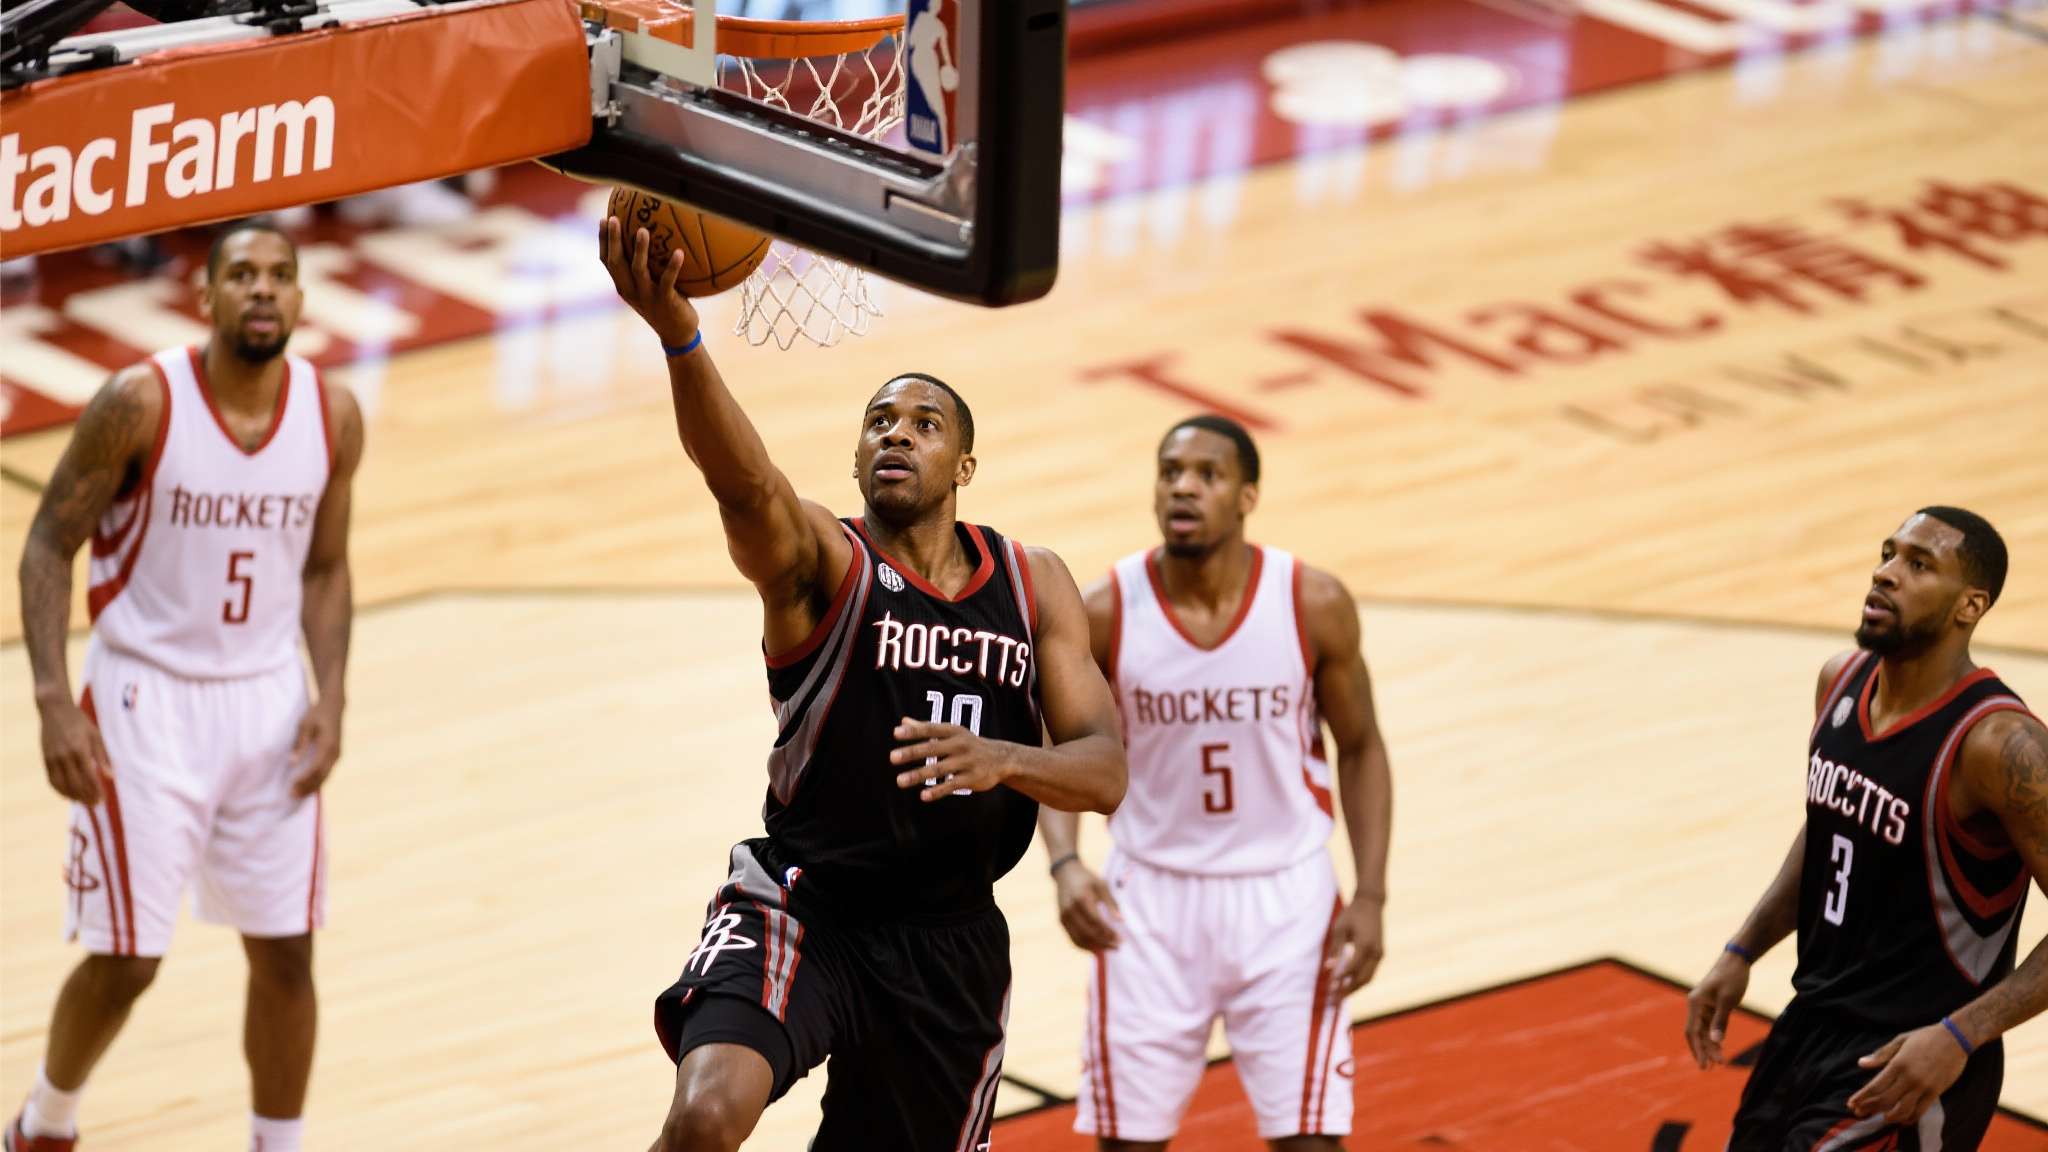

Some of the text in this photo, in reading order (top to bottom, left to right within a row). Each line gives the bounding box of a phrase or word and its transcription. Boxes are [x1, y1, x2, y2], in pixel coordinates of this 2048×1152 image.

[125, 95, 335, 208] Farm
[167, 483, 312, 530] ROCKETS
[222, 551, 254, 625] 5
[1133, 685, 1289, 724] ROCKETS
[1201, 743, 1235, 814] 5
[1824, 833, 1854, 926] 3
